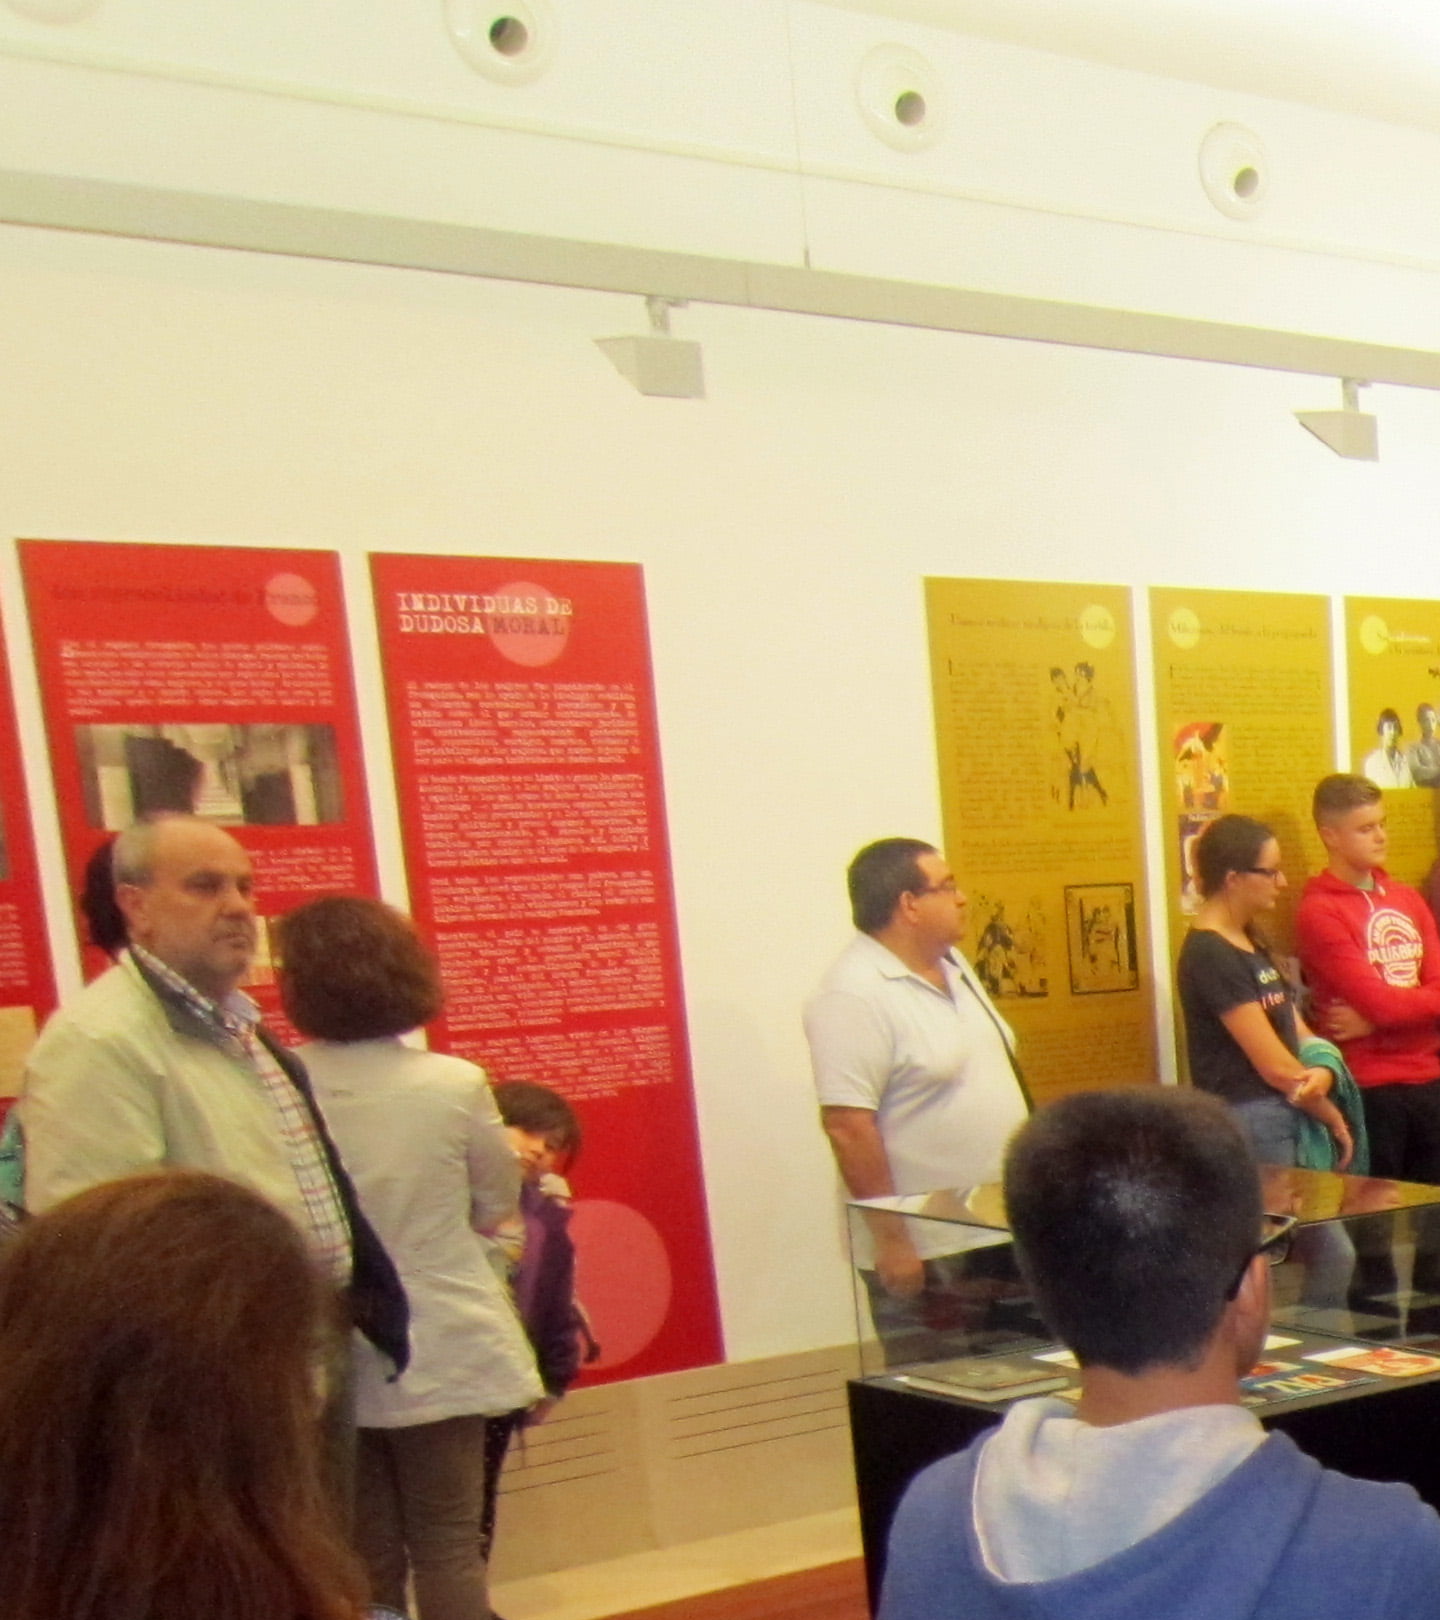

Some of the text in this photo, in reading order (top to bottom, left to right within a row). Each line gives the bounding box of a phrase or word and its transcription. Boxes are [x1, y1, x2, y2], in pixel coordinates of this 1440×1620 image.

[396, 592, 573, 616] INDIVIDUAS DE
[400, 614, 485, 634] DUDOSA
